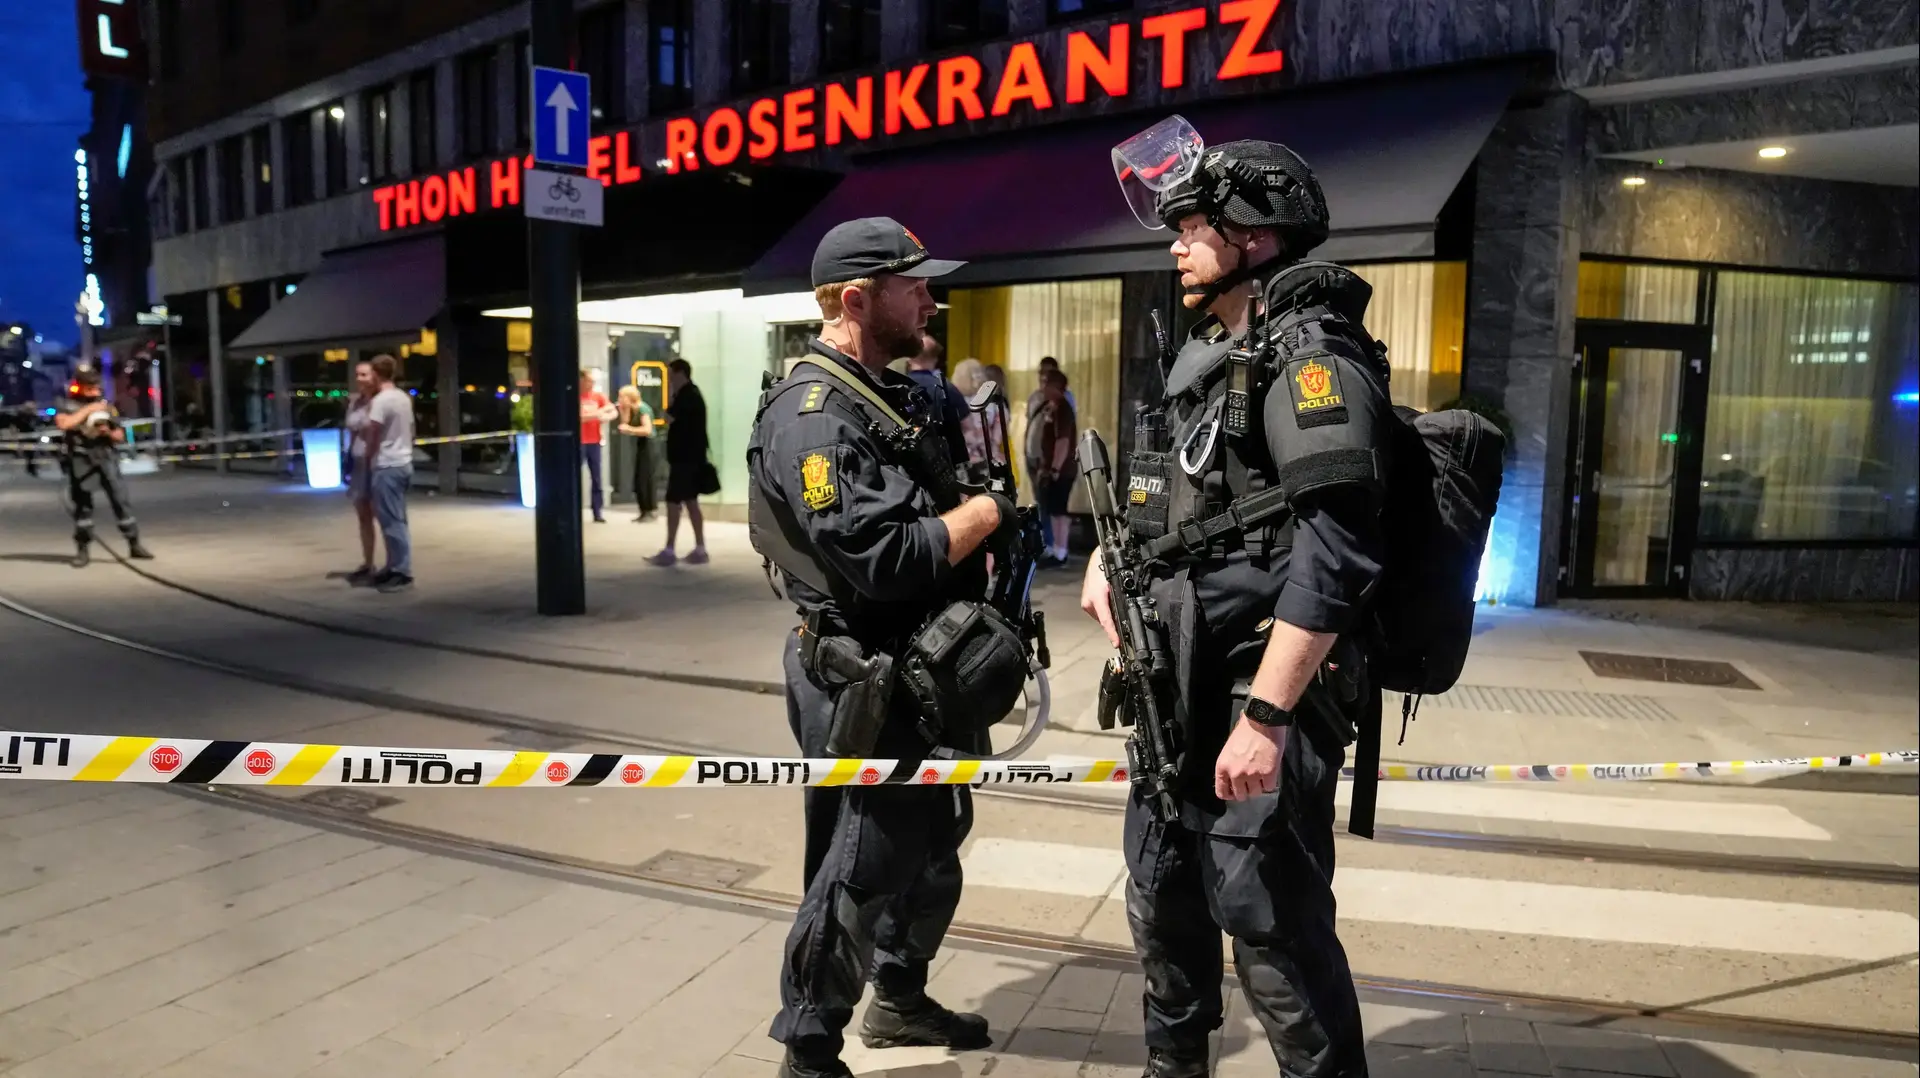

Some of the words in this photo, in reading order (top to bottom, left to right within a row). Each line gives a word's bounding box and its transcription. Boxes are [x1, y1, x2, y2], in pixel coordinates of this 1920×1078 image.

[373, 167, 476, 231] THON
[490, 131, 641, 208] HEL
[666, 0, 1284, 176] ROSENKRANTZ
[1298, 395, 1341, 411] POLITI
[1129, 475, 1163, 493] POLITI
[803, 484, 834, 502] POLITI
[0, 736, 70, 766] ITI
[152, 753, 180, 765] STOP
[248, 757, 273, 769] STOP
[340, 757, 483, 785] POLITI
[547, 767, 569, 778] STOP
[623, 769, 644, 779] STOP
[697, 761, 810, 784] POLITI
[861, 773, 880, 782] STOP
